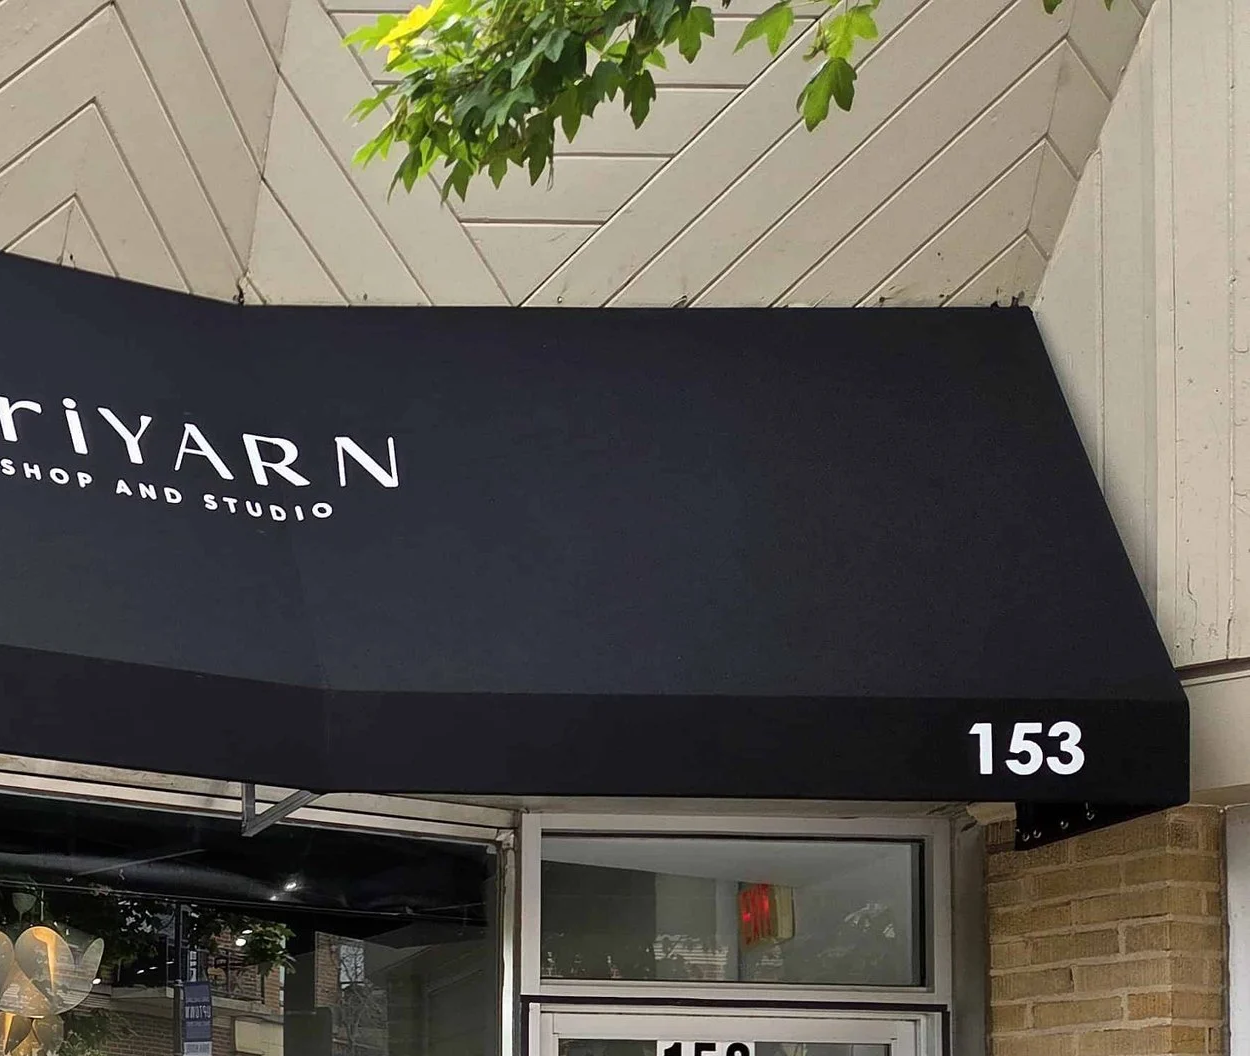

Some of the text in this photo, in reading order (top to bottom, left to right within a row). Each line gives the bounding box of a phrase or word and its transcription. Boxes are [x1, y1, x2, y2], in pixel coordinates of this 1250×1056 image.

[1, 457, 333, 522] SHOP AND STUDIO
[969, 721, 1085, 776] 153
